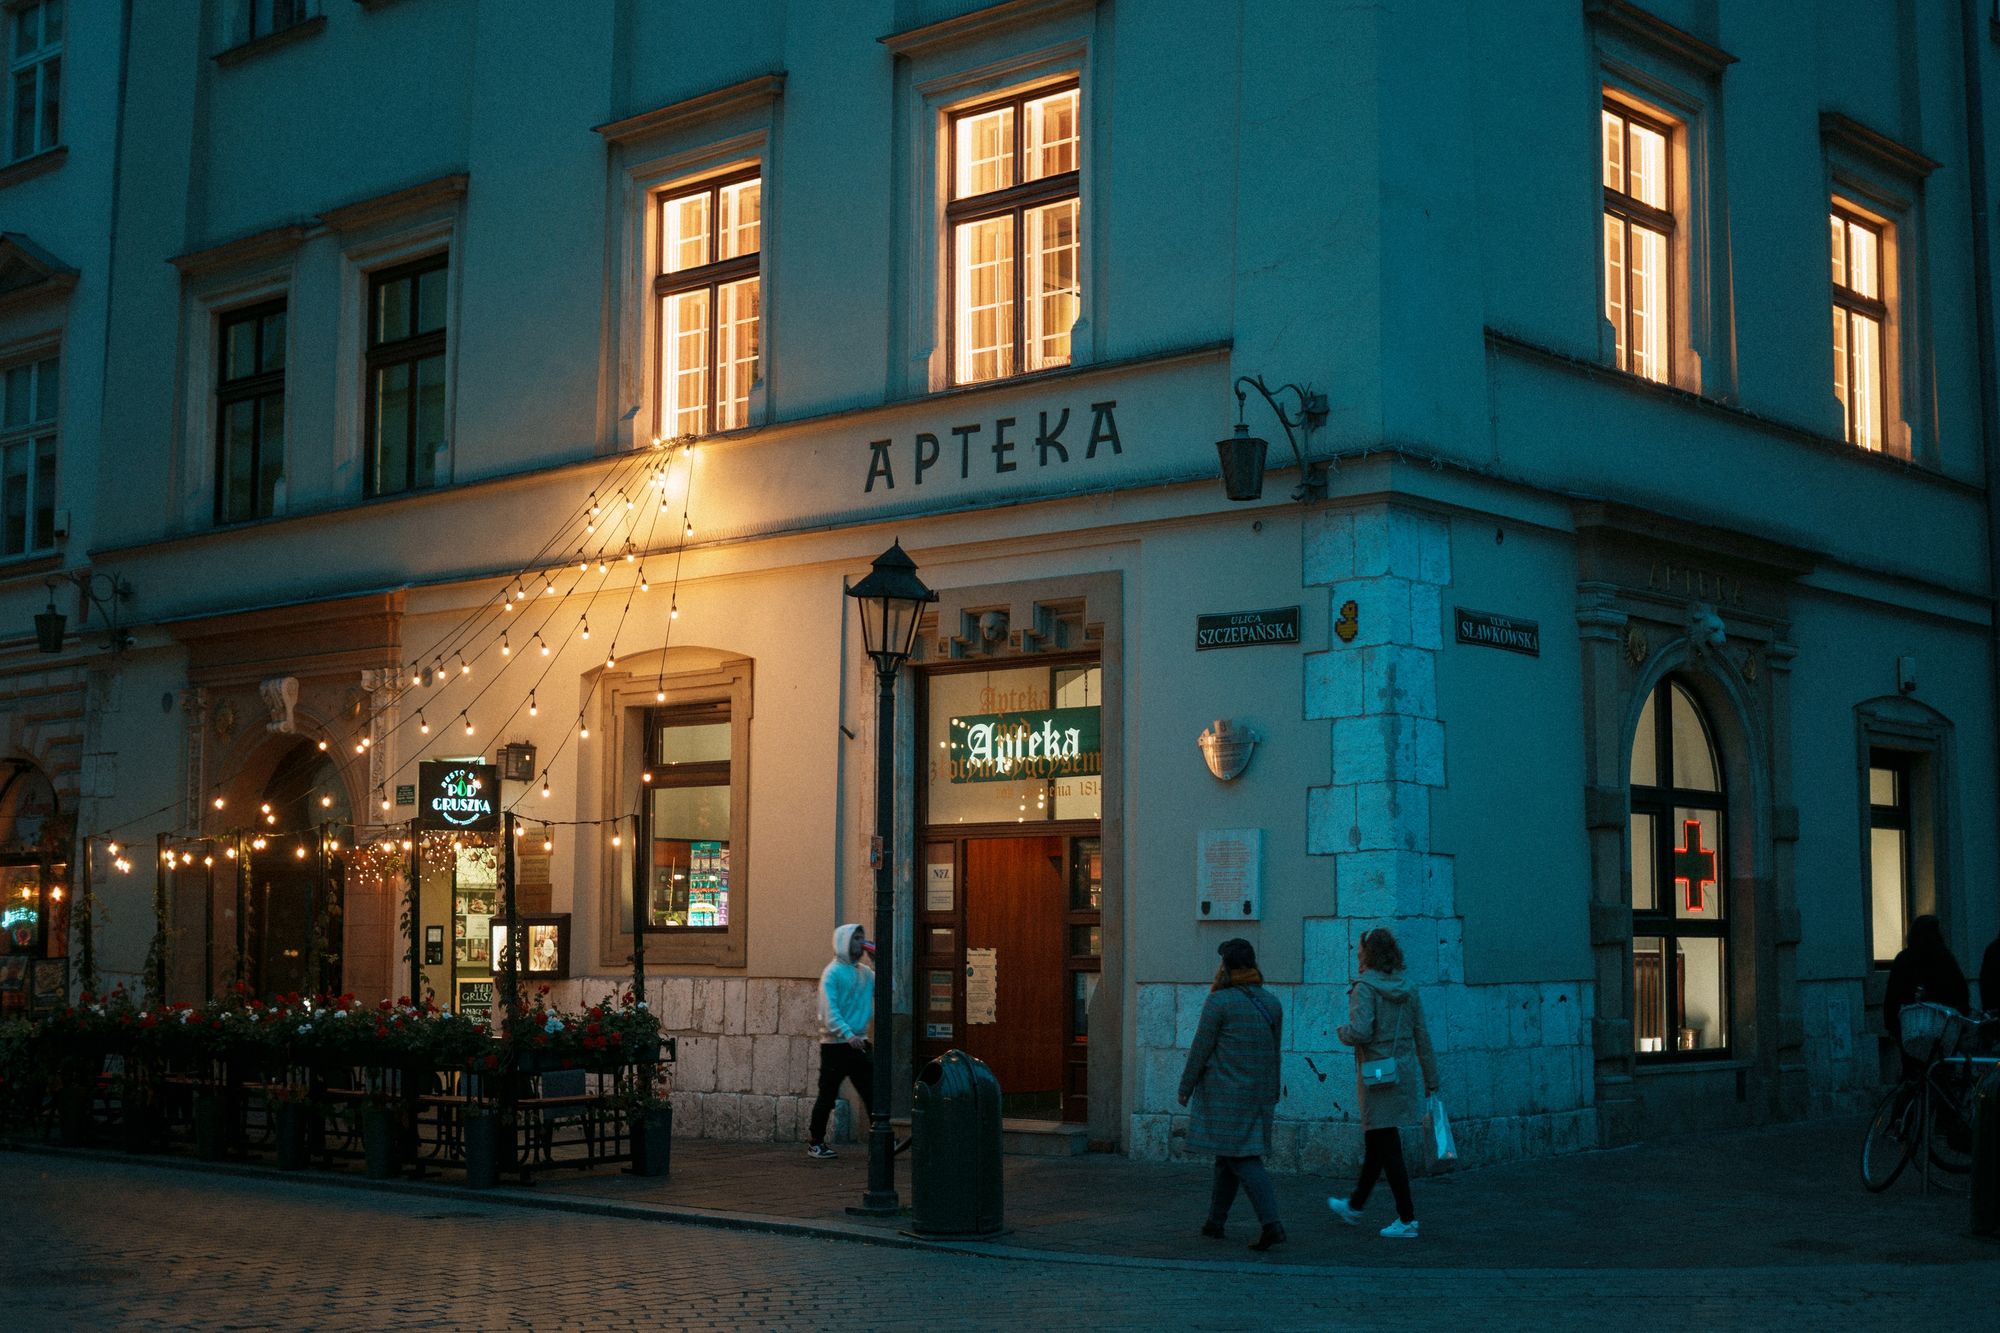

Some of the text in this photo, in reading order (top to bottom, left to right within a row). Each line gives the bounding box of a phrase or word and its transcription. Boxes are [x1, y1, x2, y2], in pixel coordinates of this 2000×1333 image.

[864, 400, 1122, 493] APTEKA
[1199, 622, 1295, 645] SZCZEPAŃSKA
[1231, 615, 1261, 625] ULICA
[1462, 620, 1538, 650] SŁAWKOWSKA
[979, 685, 1049, 718] Apteka
[966, 719, 1081, 774] Apteka
[1080, 781, 1102, 796] 181
